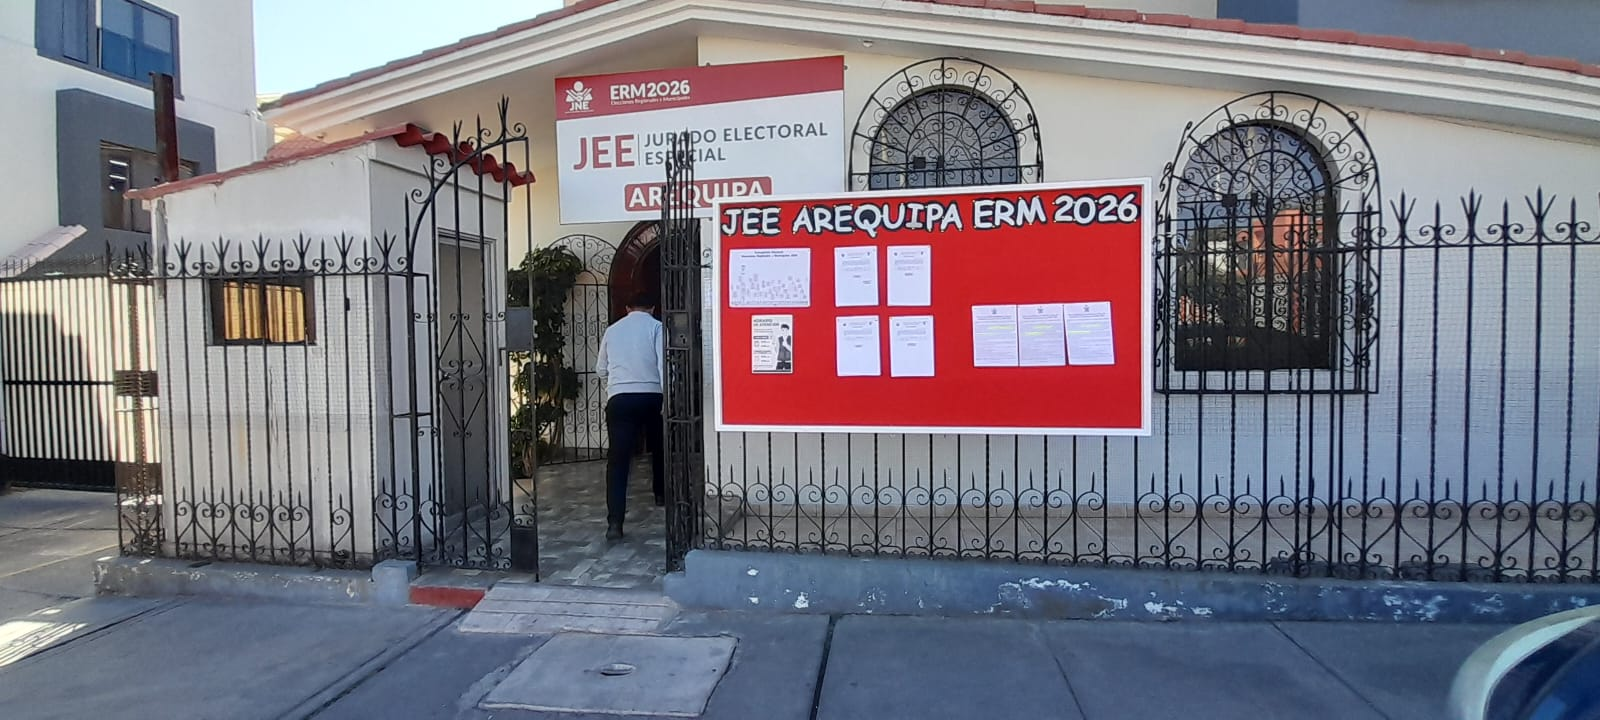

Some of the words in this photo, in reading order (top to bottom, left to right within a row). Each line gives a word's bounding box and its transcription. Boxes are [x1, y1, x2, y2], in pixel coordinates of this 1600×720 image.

[610, 80, 690, 100] ERM2026
[569, 101, 589, 111] JNE
[644, 129, 717, 147] JURADO
[724, 122, 828, 142] ELECTORAL
[573, 134, 635, 170] JEE
[721, 206, 781, 236] JEE
[792, 202, 963, 238] AREQUIPA
[973, 195, 1048, 230] ERM
[1054, 193, 1140, 225] 2026
